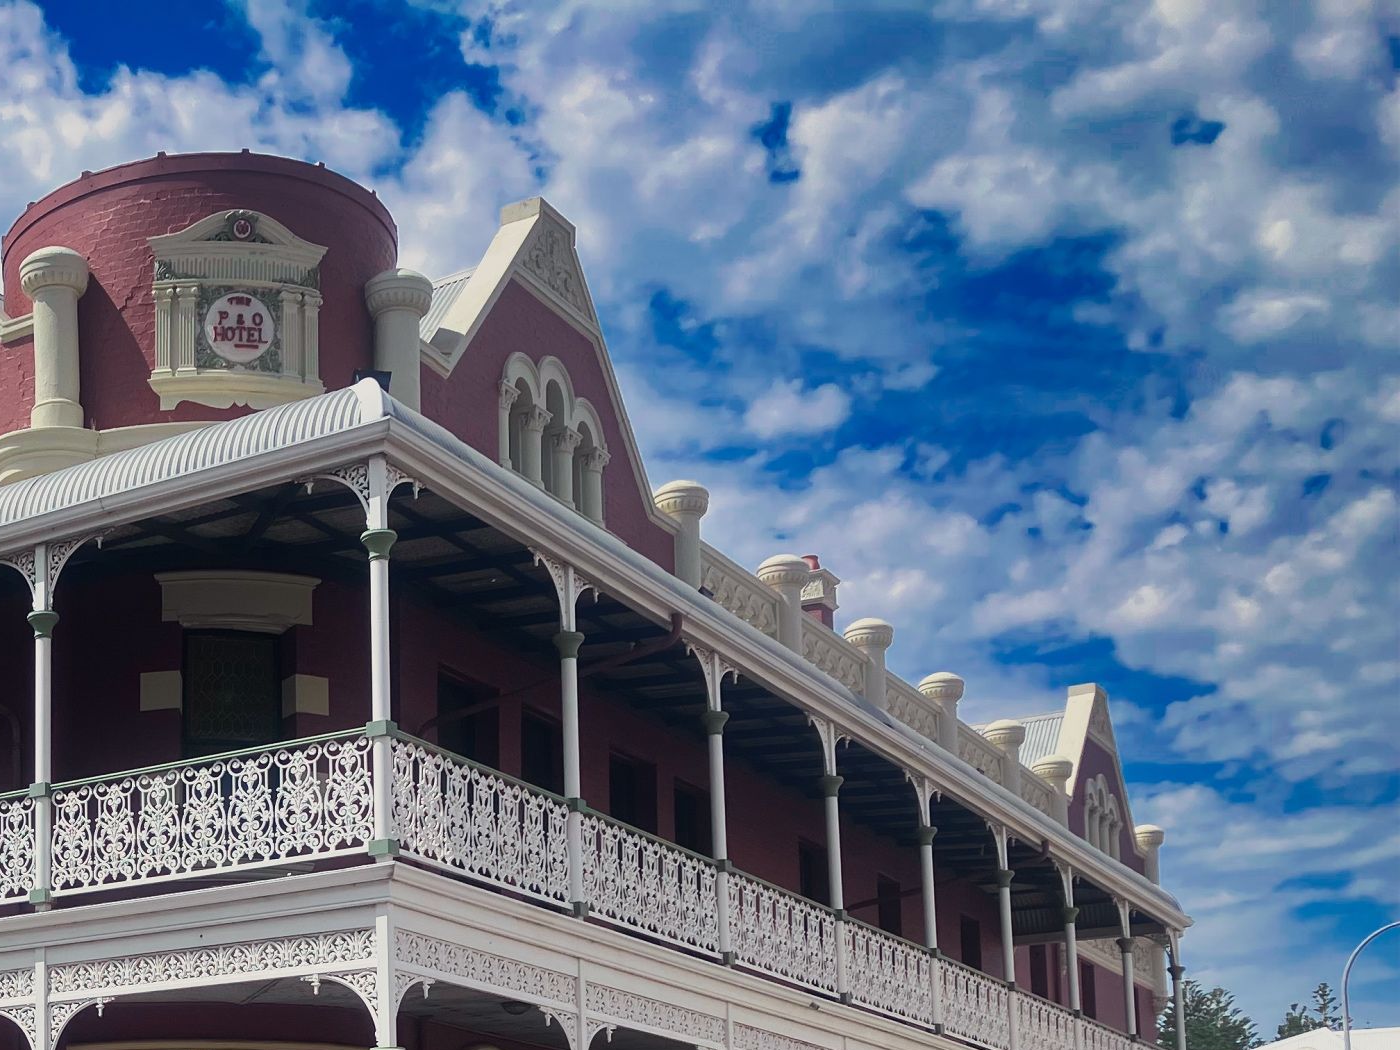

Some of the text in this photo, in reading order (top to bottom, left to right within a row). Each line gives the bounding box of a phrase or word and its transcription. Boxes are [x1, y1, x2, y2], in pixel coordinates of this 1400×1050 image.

[227, 295, 252, 306] THE
[218, 311, 229, 325] P
[252, 312, 264, 326] O
[213, 326, 269, 344] HOTEL
